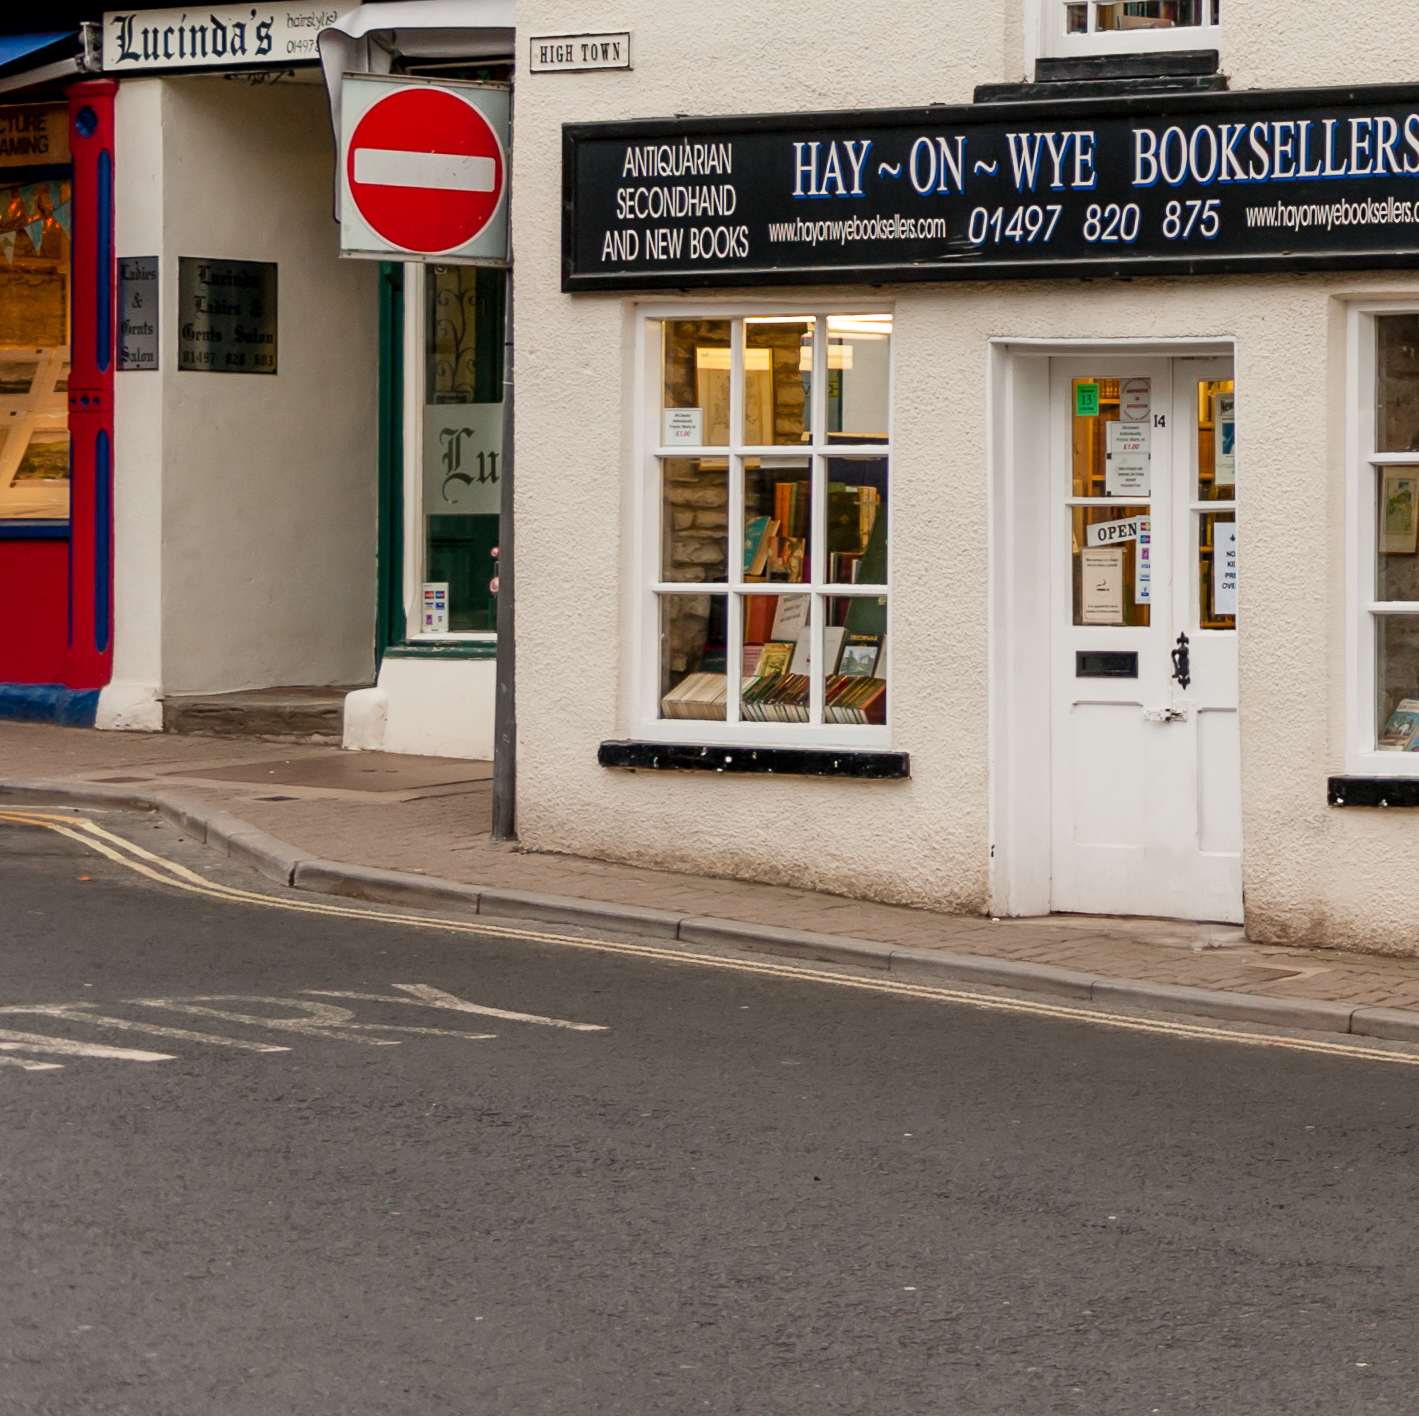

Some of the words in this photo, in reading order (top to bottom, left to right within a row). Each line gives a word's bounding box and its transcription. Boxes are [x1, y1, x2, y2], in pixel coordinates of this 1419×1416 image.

[110, 9, 274, 64] Lucinda's
[540, 44, 573, 63] HIGH
[581, 42, 621, 61] TOWN
[622, 143, 732, 177] ANTIQUARIAN
[617, 185, 737, 219] SECONDHAND
[768, 214, 946, 245] www.hayonwyebooksellers.com
[967, 204, 1062, 245] 01497
[1083, 203, 1142, 243] 820
[1162, 199, 1221, 241] 875
[602, 230, 639, 261] AND
[646, 228, 684, 260] NEW
[690, 225, 749, 260] BOOKS
[120, 346, 154, 363] Salon
[1098, 523, 1137, 541] OPEN
